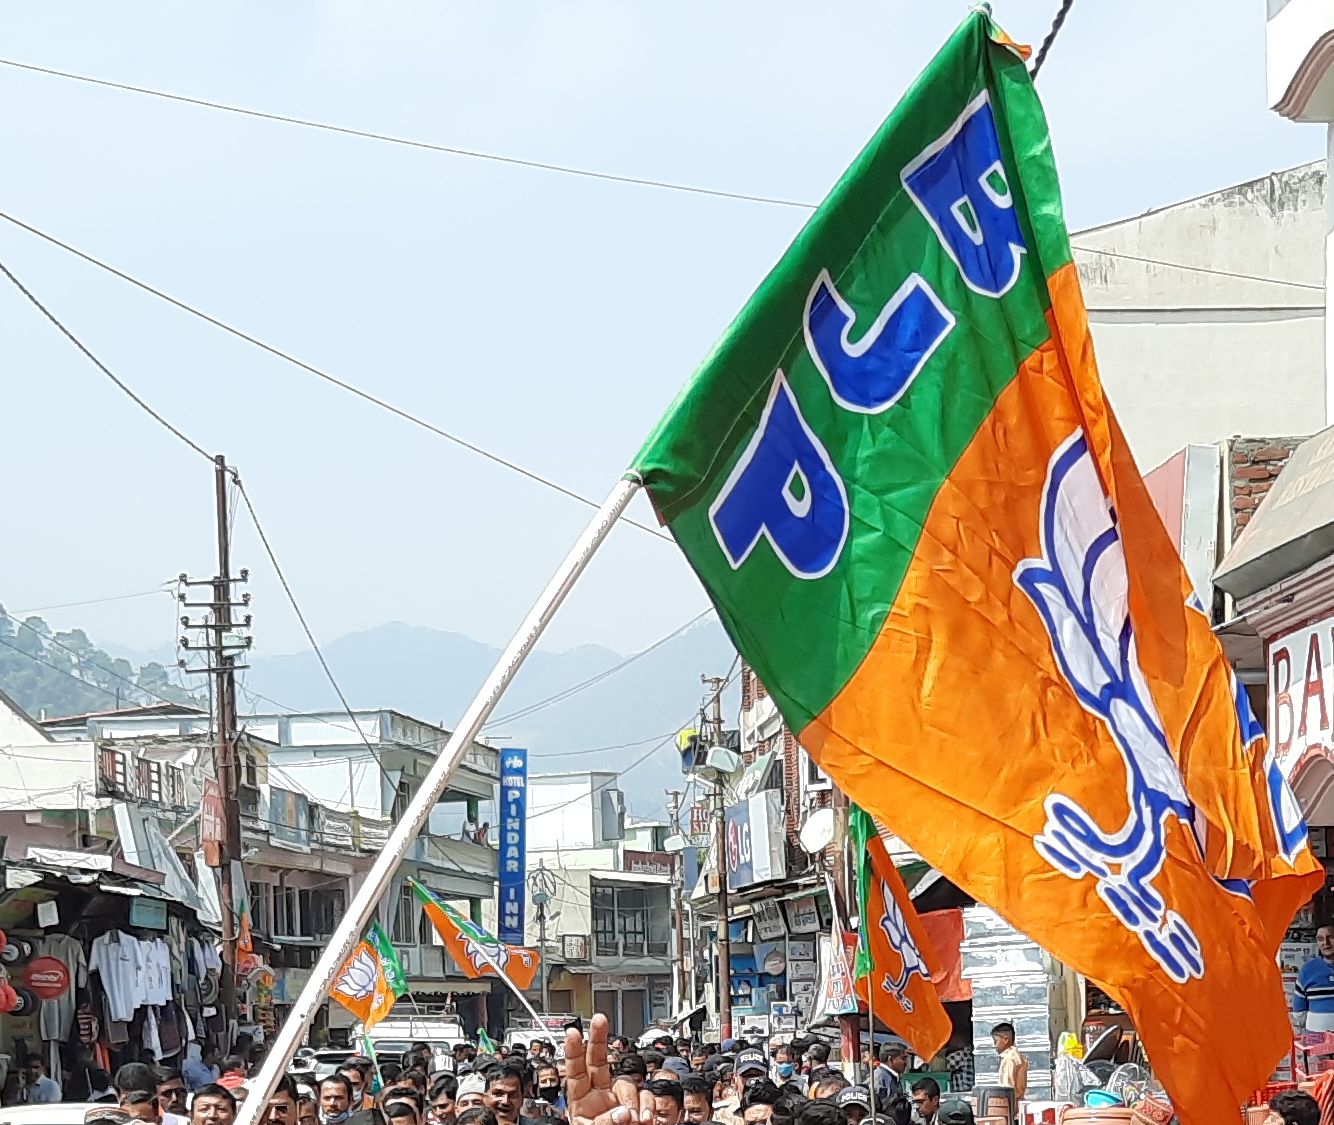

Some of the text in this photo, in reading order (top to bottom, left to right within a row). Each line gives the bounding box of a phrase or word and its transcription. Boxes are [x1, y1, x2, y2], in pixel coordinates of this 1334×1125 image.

[505, 789, 521, 873] PINDAR
[737, 822, 752, 865] LG
[504, 887, 519, 928] INN
